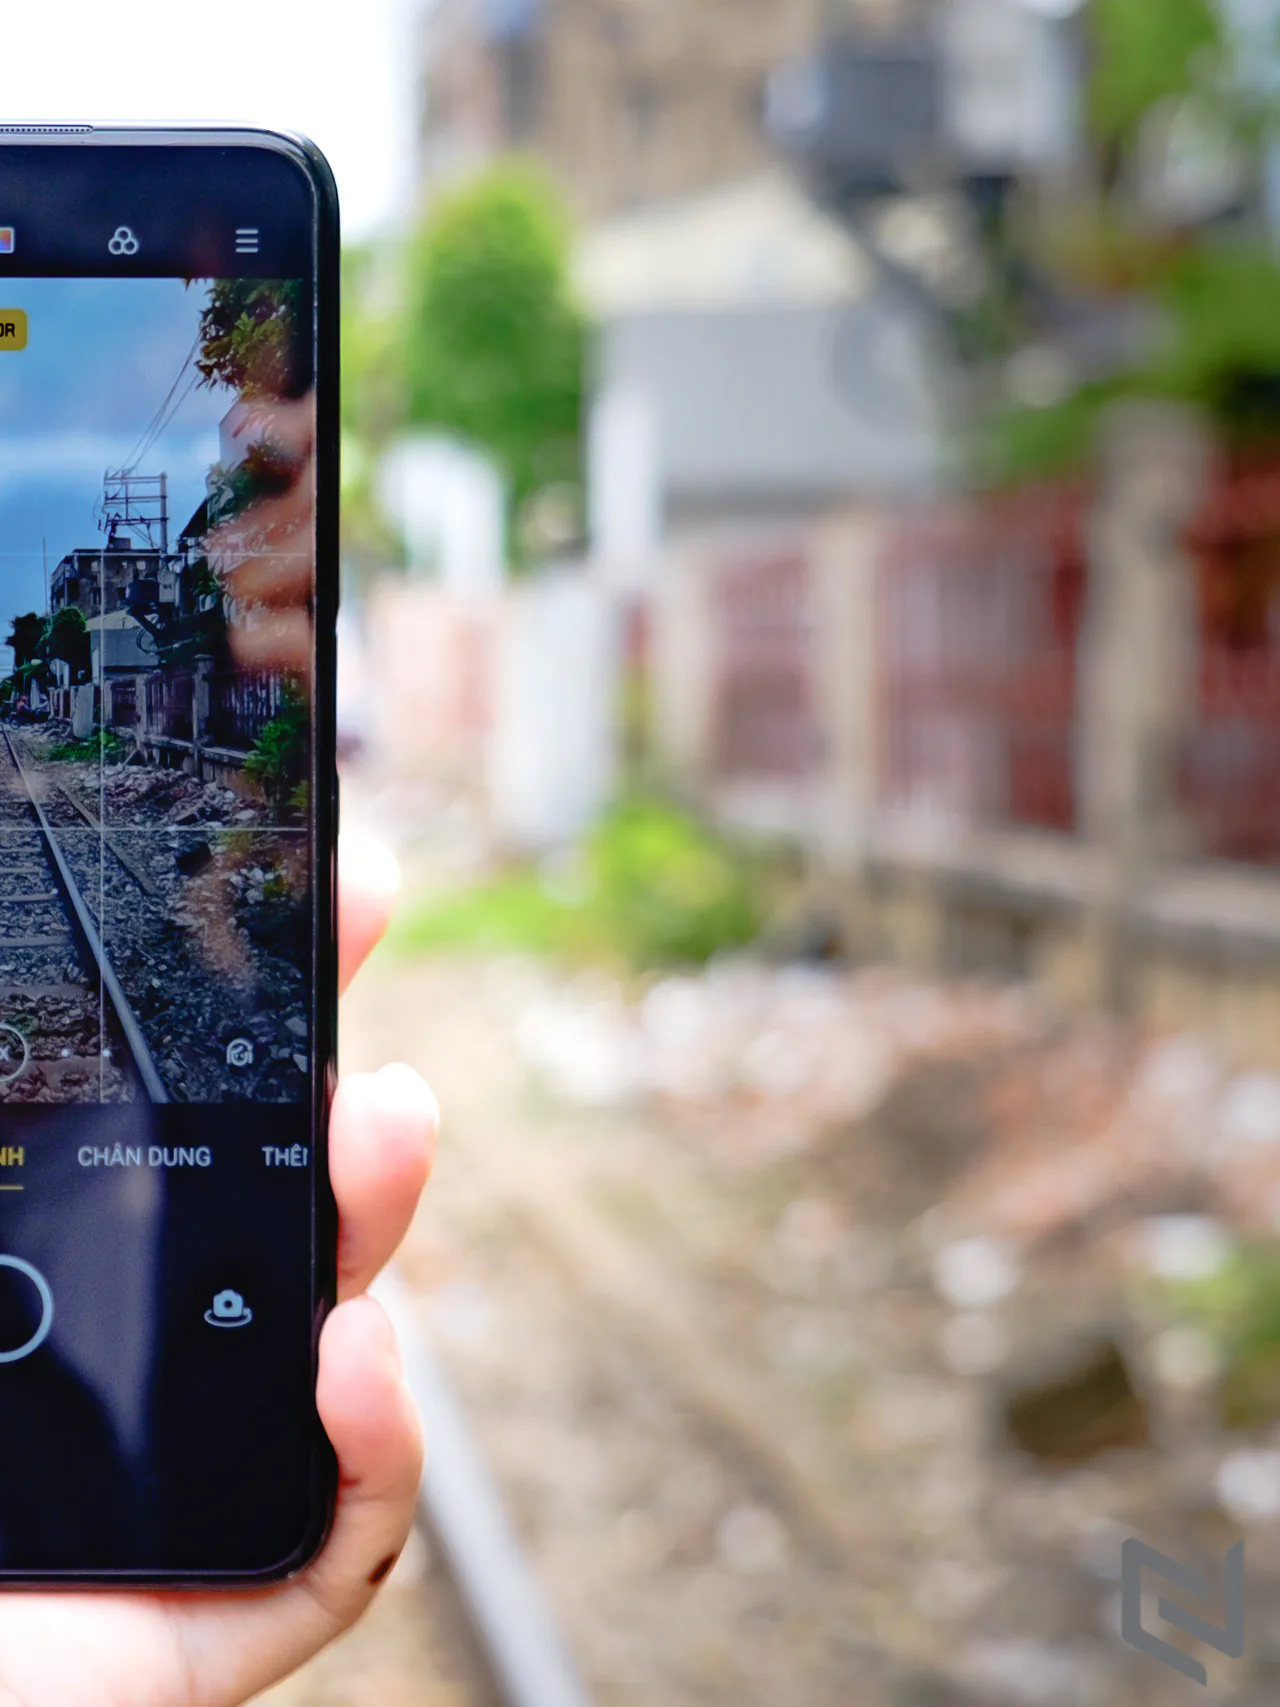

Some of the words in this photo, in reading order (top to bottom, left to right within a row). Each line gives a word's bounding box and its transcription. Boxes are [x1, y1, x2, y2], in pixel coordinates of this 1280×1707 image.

[77, 1143, 141, 1167] CHÂN
[148, 1146, 212, 1167] DUNG
[261, 1144, 308, 1167] THÊ
